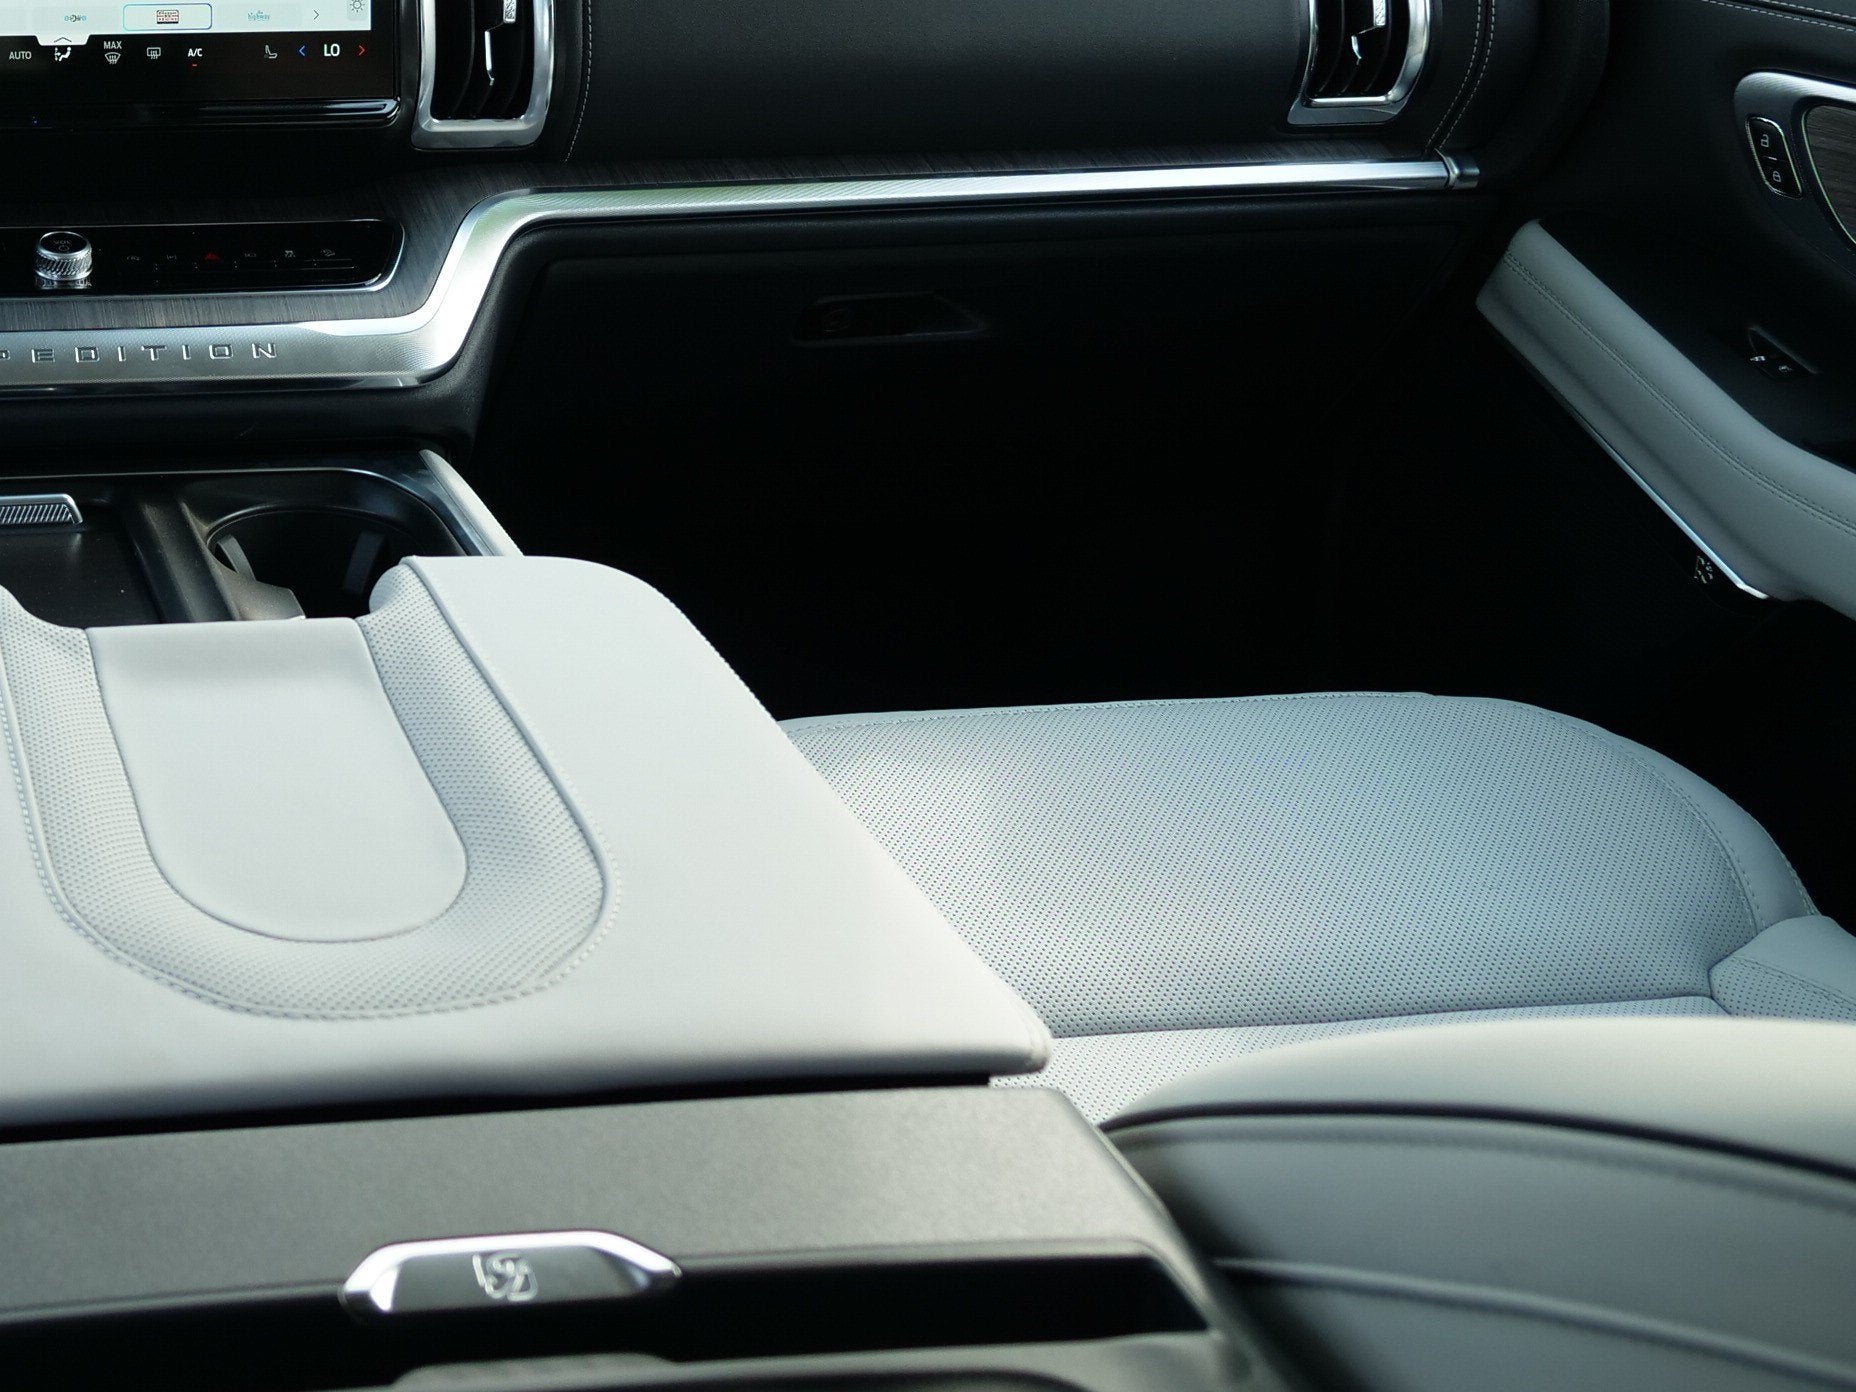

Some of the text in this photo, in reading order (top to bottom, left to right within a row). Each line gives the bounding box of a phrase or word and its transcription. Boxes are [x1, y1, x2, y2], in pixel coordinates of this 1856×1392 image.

[103, 40, 123, 50] MAX
[323, 43, 341, 58] LO
[8, 51, 32, 61] AUTO
[187, 47, 203, 59] A/C
